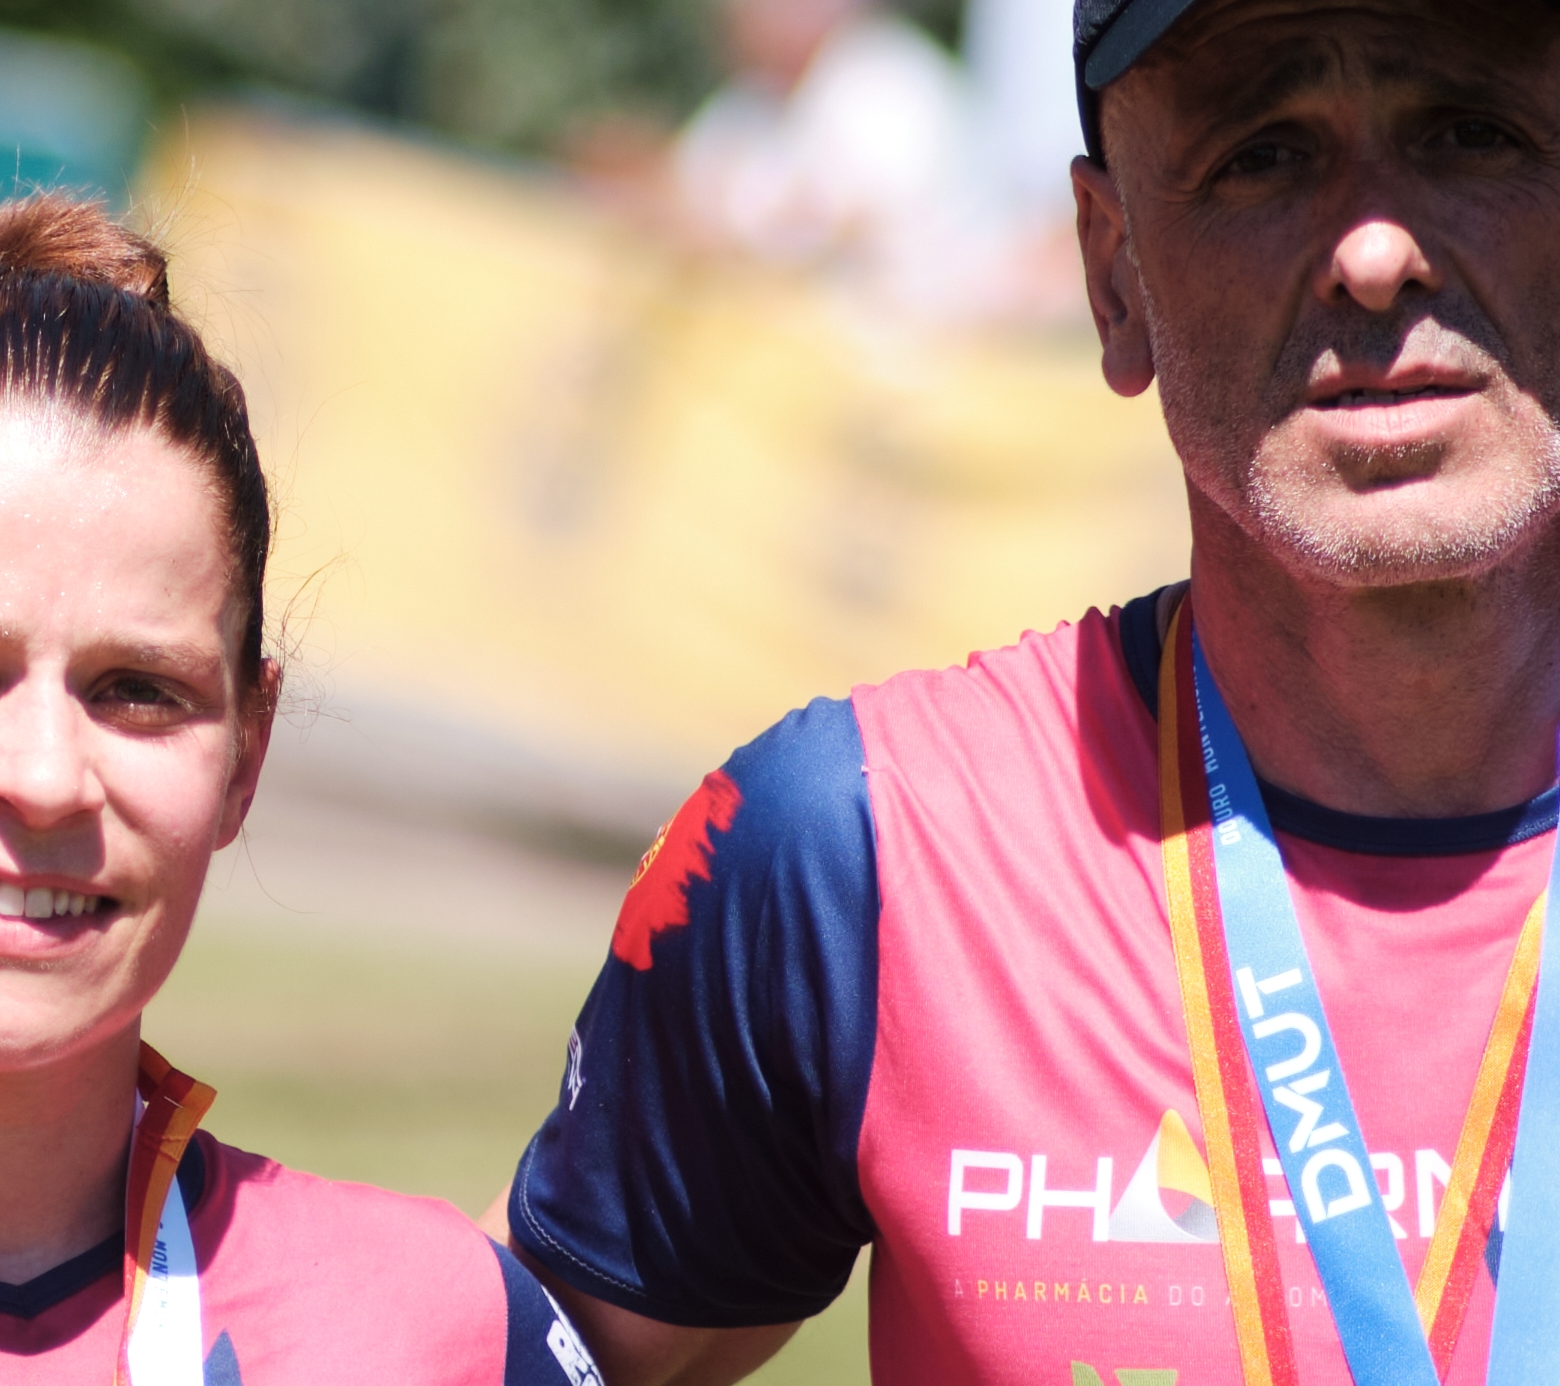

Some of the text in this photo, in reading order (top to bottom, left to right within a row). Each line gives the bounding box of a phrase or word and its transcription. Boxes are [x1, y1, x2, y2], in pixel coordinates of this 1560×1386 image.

[1236, 966, 1373, 1224] DMUT
[977, 1277, 1149, 1305] PHARMÁCIA
[1168, 1285, 1206, 1308] DO
